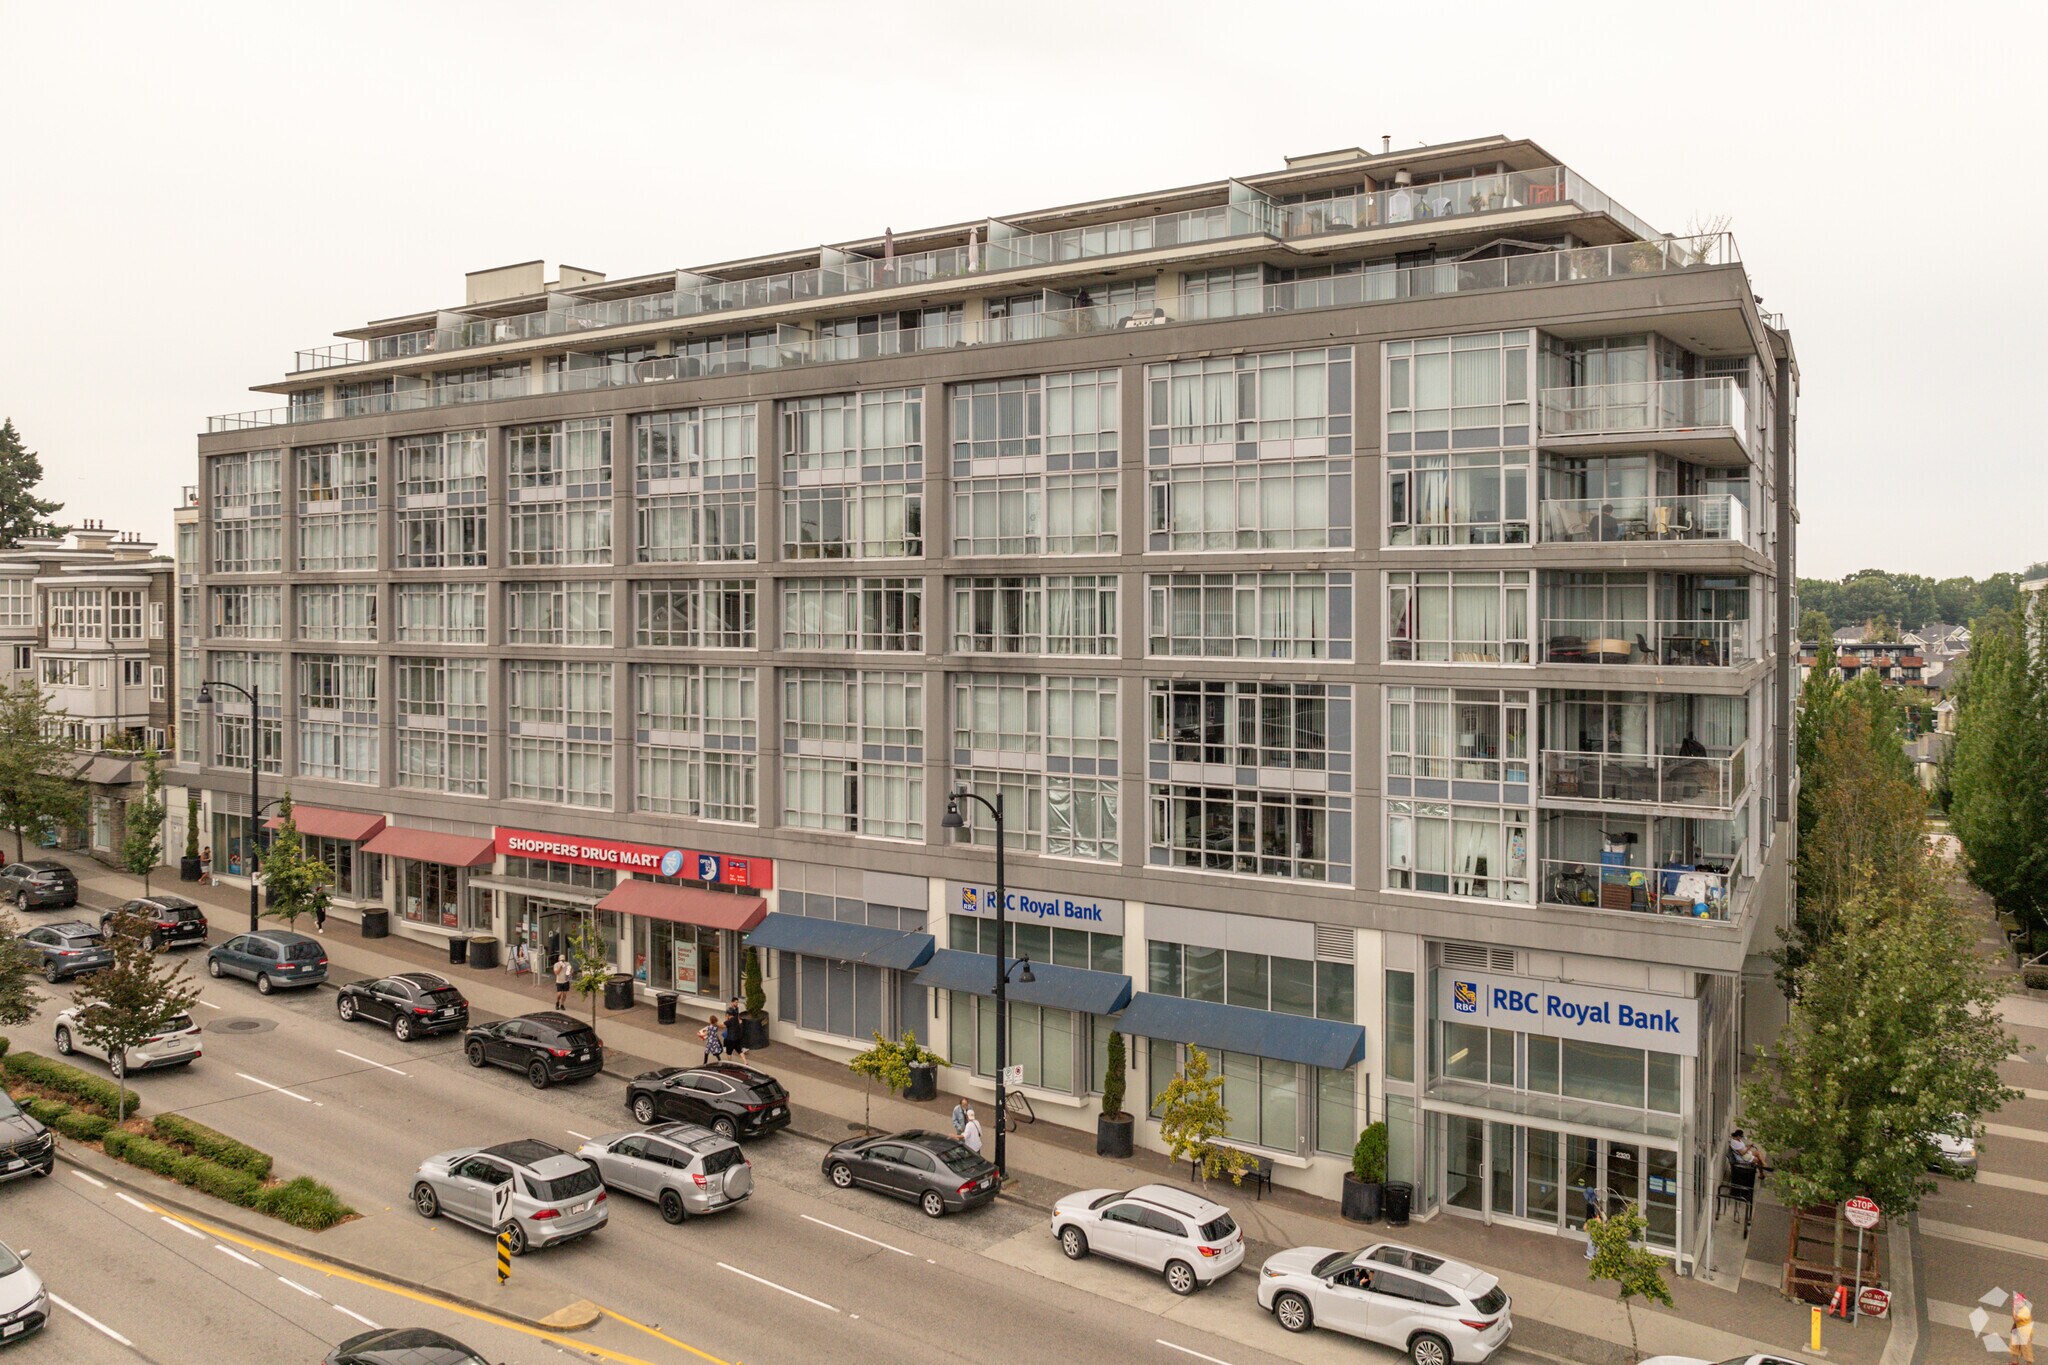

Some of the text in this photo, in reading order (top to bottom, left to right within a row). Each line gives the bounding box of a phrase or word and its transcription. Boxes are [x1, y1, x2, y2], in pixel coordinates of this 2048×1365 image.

[508, 837, 661, 868] SHOPPERS DRUG MART
[963, 903, 976, 911] RBC
[987, 891, 1103, 922] RC Royal Bank
[1456, 1002, 1476, 1013] RBC
[1493, 988, 1681, 1034] RBC Royal Bank
[1615, 1151, 1631, 1160] 2320
[1851, 1199, 1873, 1210] STOP
[1873, 1293, 1886, 1301] NOT
[1863, 1303, 1881, 1312] ENTER
